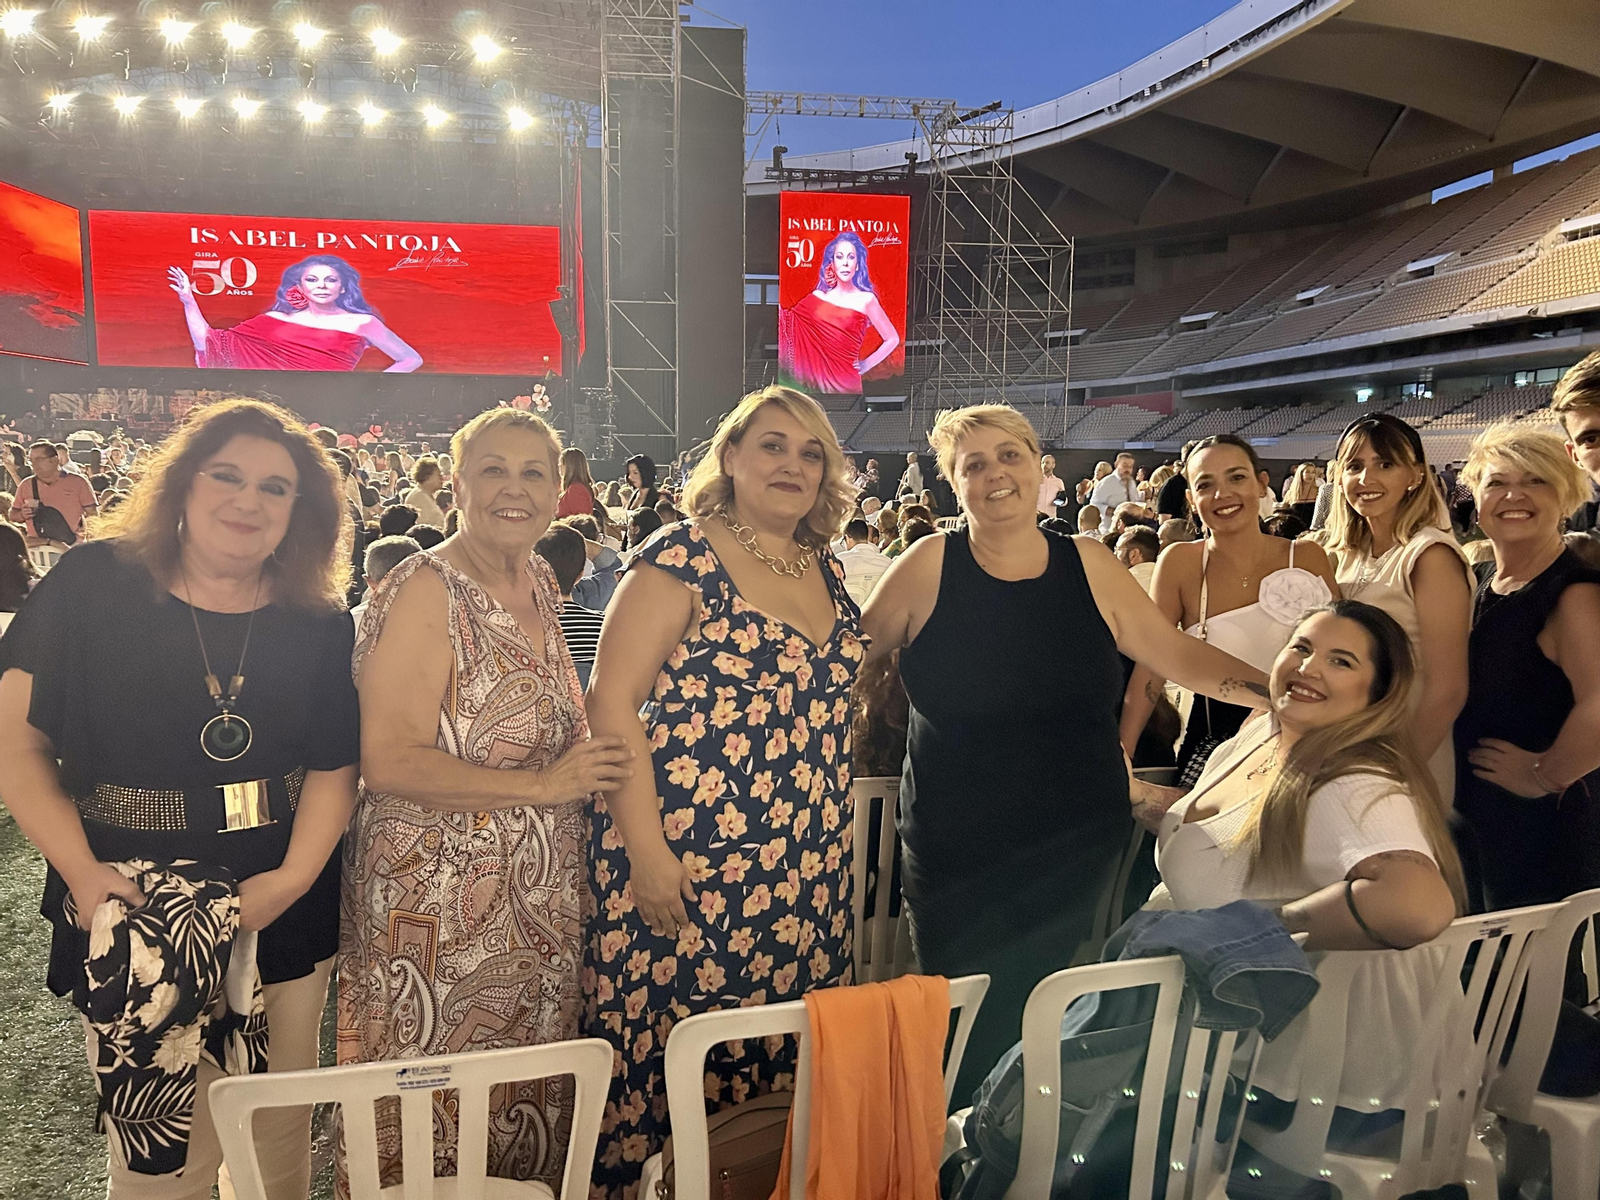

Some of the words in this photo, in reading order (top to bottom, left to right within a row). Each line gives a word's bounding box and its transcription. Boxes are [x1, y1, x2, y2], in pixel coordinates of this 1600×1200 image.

[788, 217, 835, 231] ISABEL
[839, 219, 899, 233] PANTOJA
[190, 227, 306, 248] ISABEL
[316, 231, 462, 253] PANTOJA
[786, 238, 815, 268] 50
[191, 256, 258, 296] 50
[226, 288, 254, 296] AÑOS
